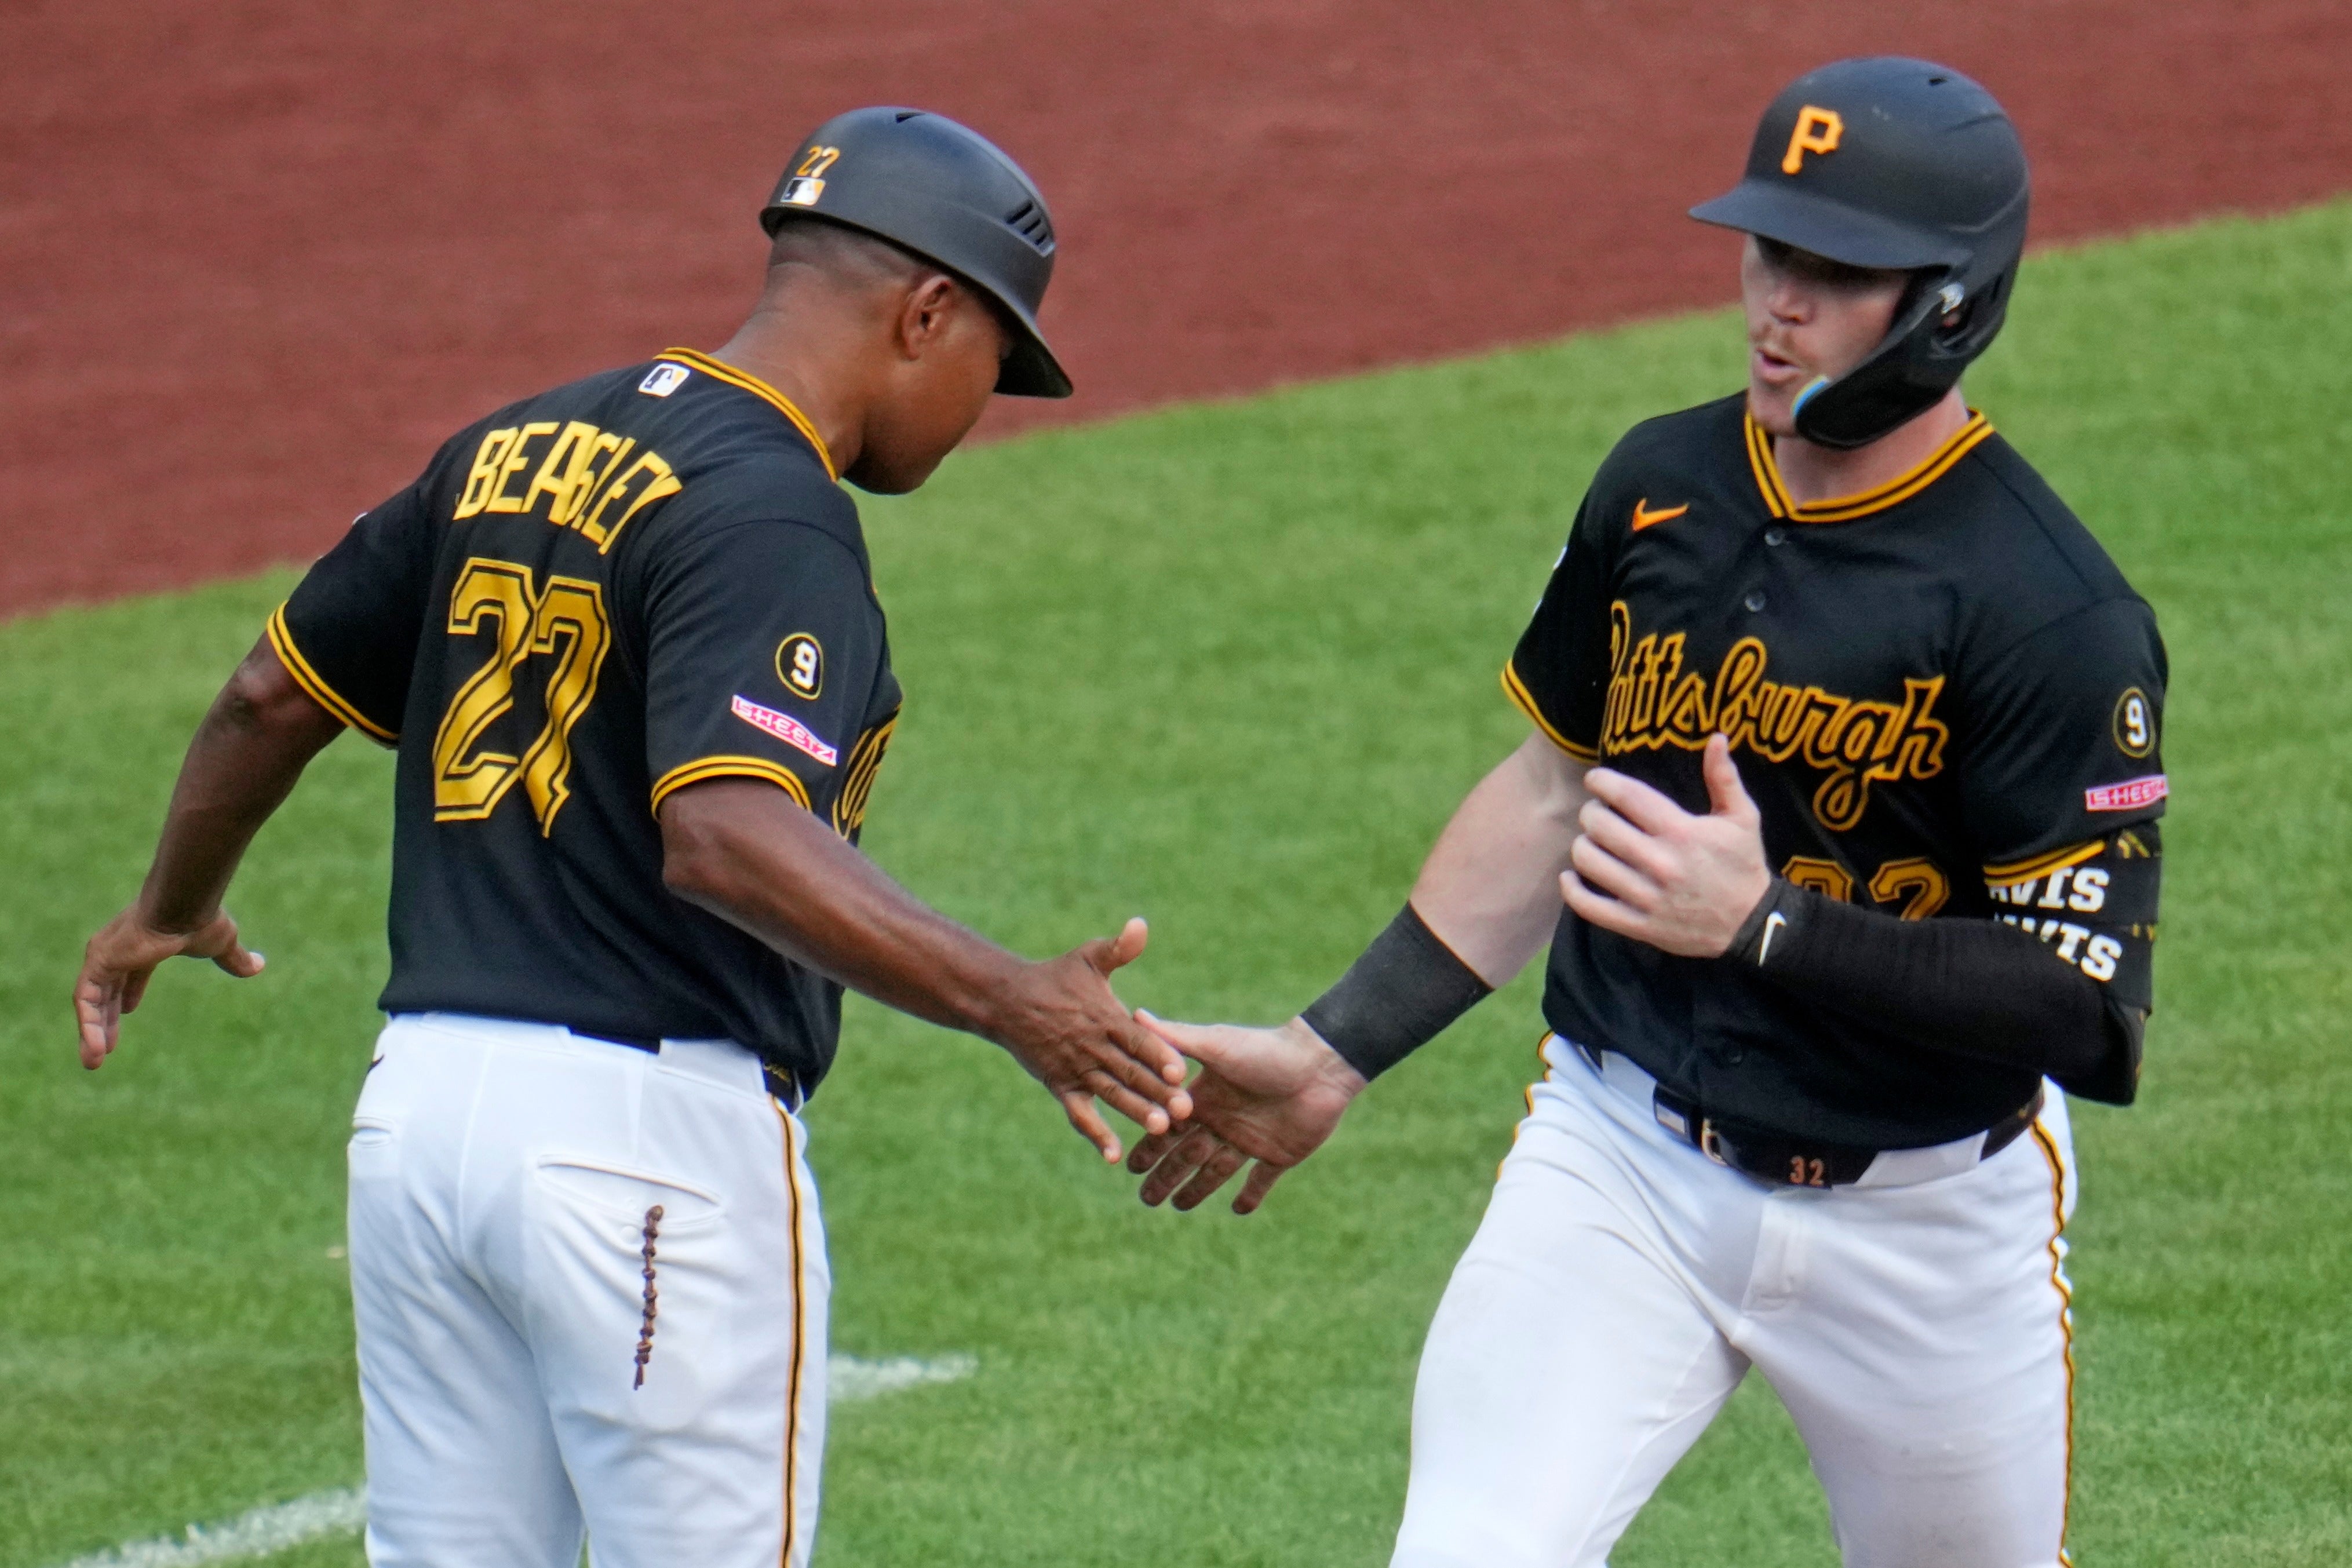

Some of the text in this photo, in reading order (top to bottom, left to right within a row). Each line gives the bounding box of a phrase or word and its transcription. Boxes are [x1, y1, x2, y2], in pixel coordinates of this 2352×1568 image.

[796, 145, 840, 178] 27
[1781, 105, 1845, 176] P
[791, 641, 817, 690] 9
[432, 557, 611, 838] 27
[2125, 698, 2147, 746] 9
[736, 702, 832, 757] SHEETZ
[1789, 1155, 1825, 1186] 32
